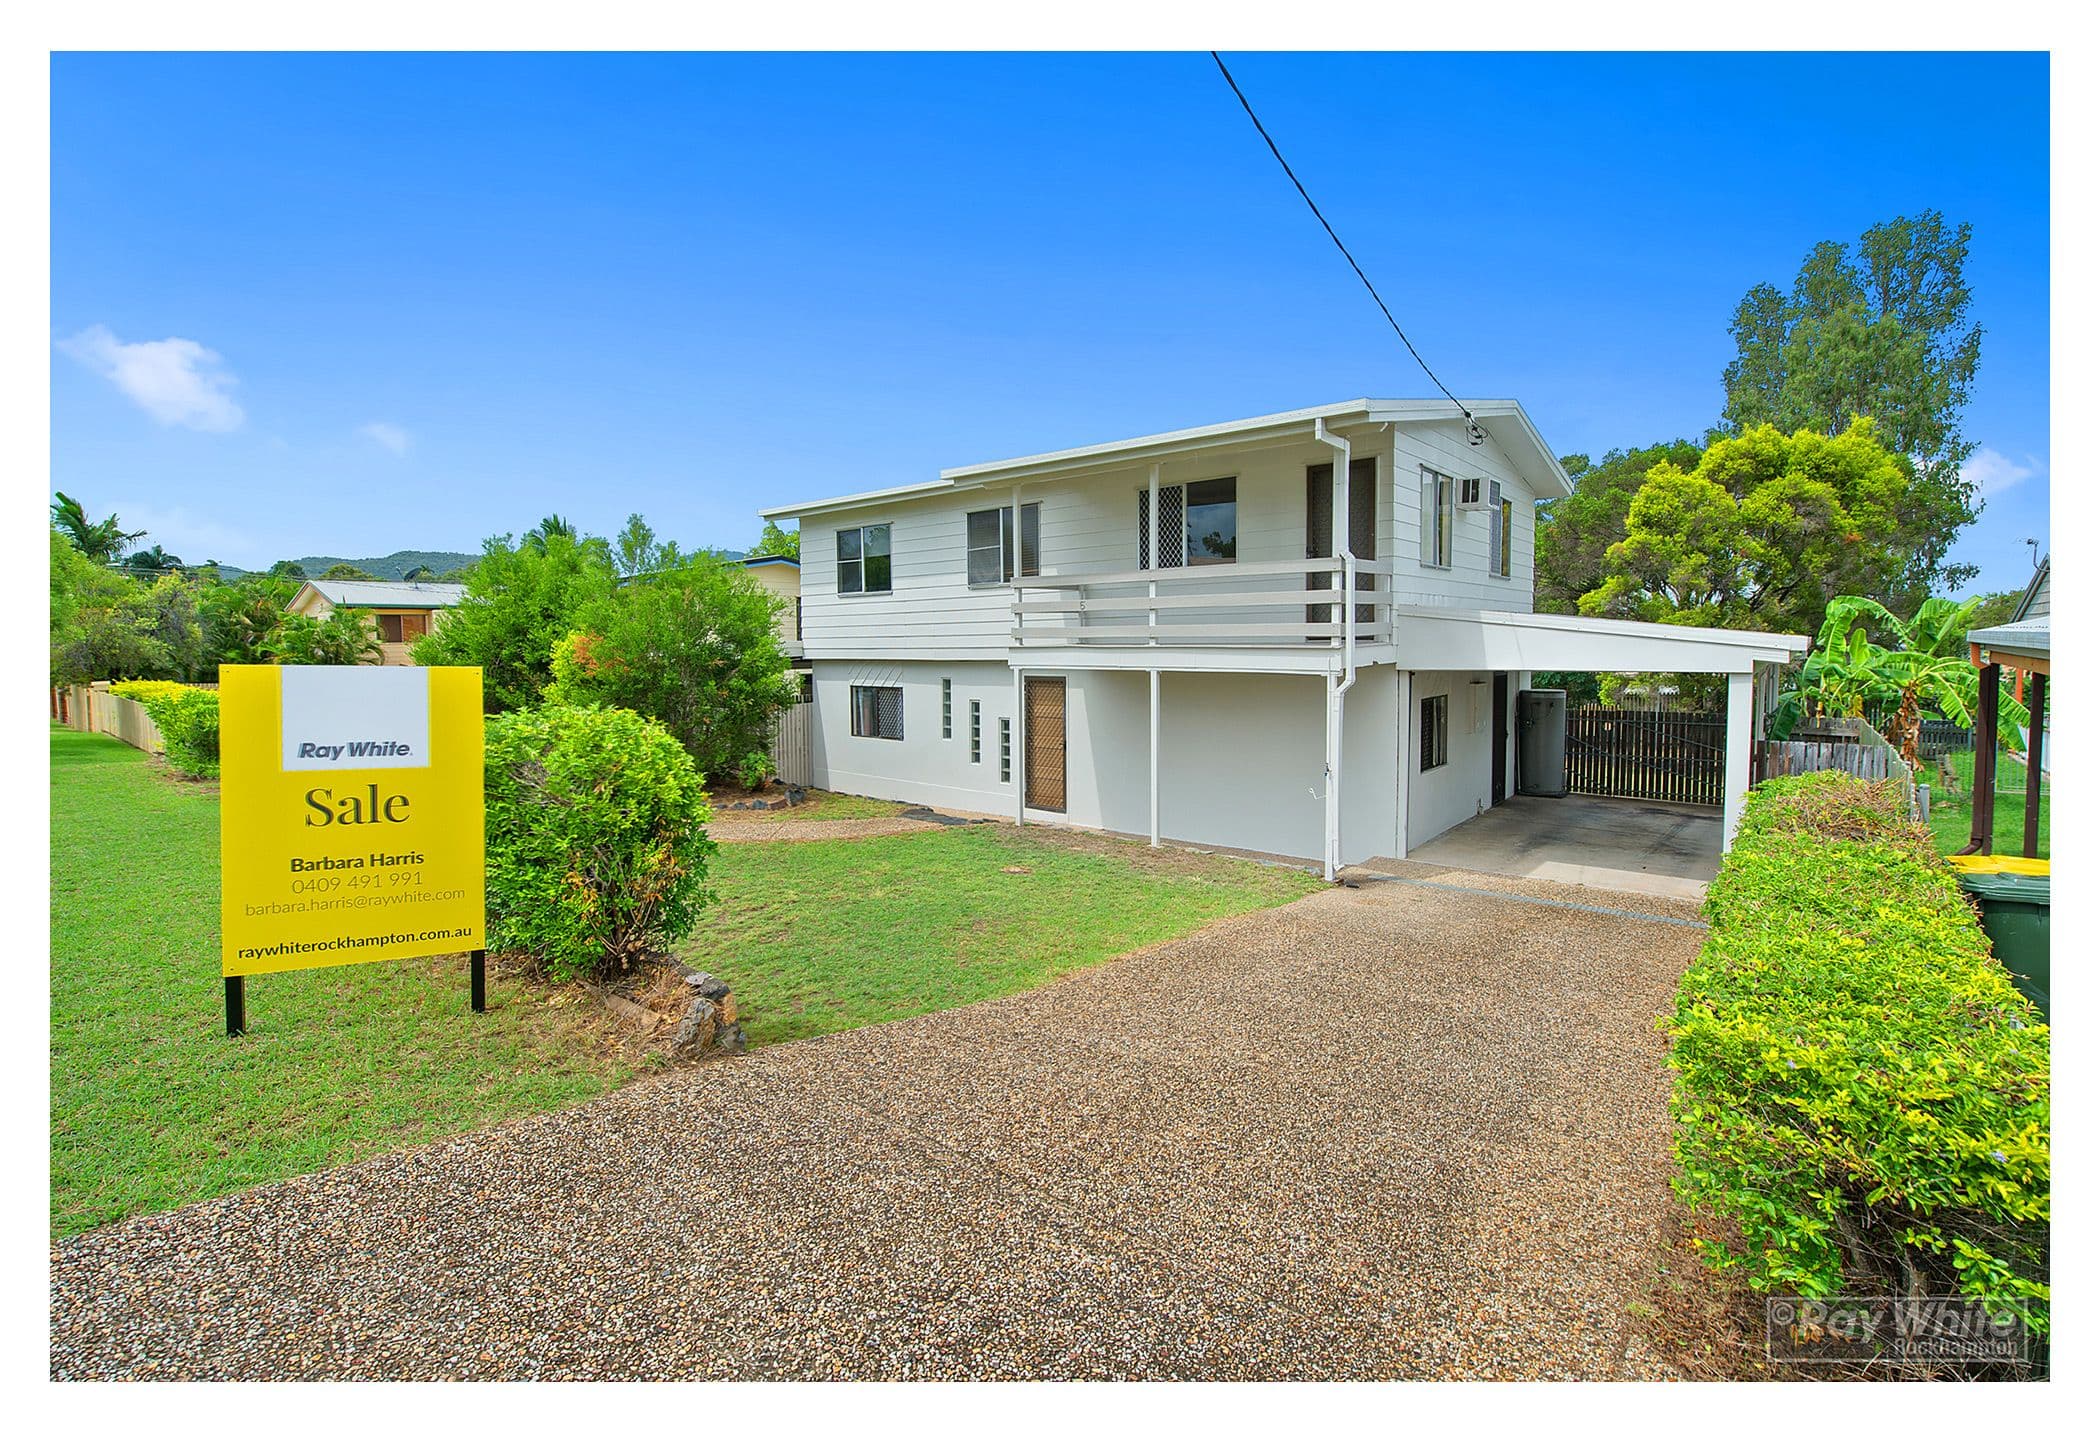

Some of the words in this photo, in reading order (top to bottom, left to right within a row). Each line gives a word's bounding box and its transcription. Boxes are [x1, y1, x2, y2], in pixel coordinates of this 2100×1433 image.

[297, 741, 344, 761] Ray
[304, 783, 411, 828] Sale
[290, 856, 364, 873] Barbara
[370, 851, 425, 867] Harris
[292, 877, 341, 894] 0409
[347, 874, 382, 891] 491
[389, 871, 424, 887] 991
[245, 887, 466, 917] barbara.harris@raywhite.com
[238, 925, 472, 959] raywhiterockhampton.com.au
